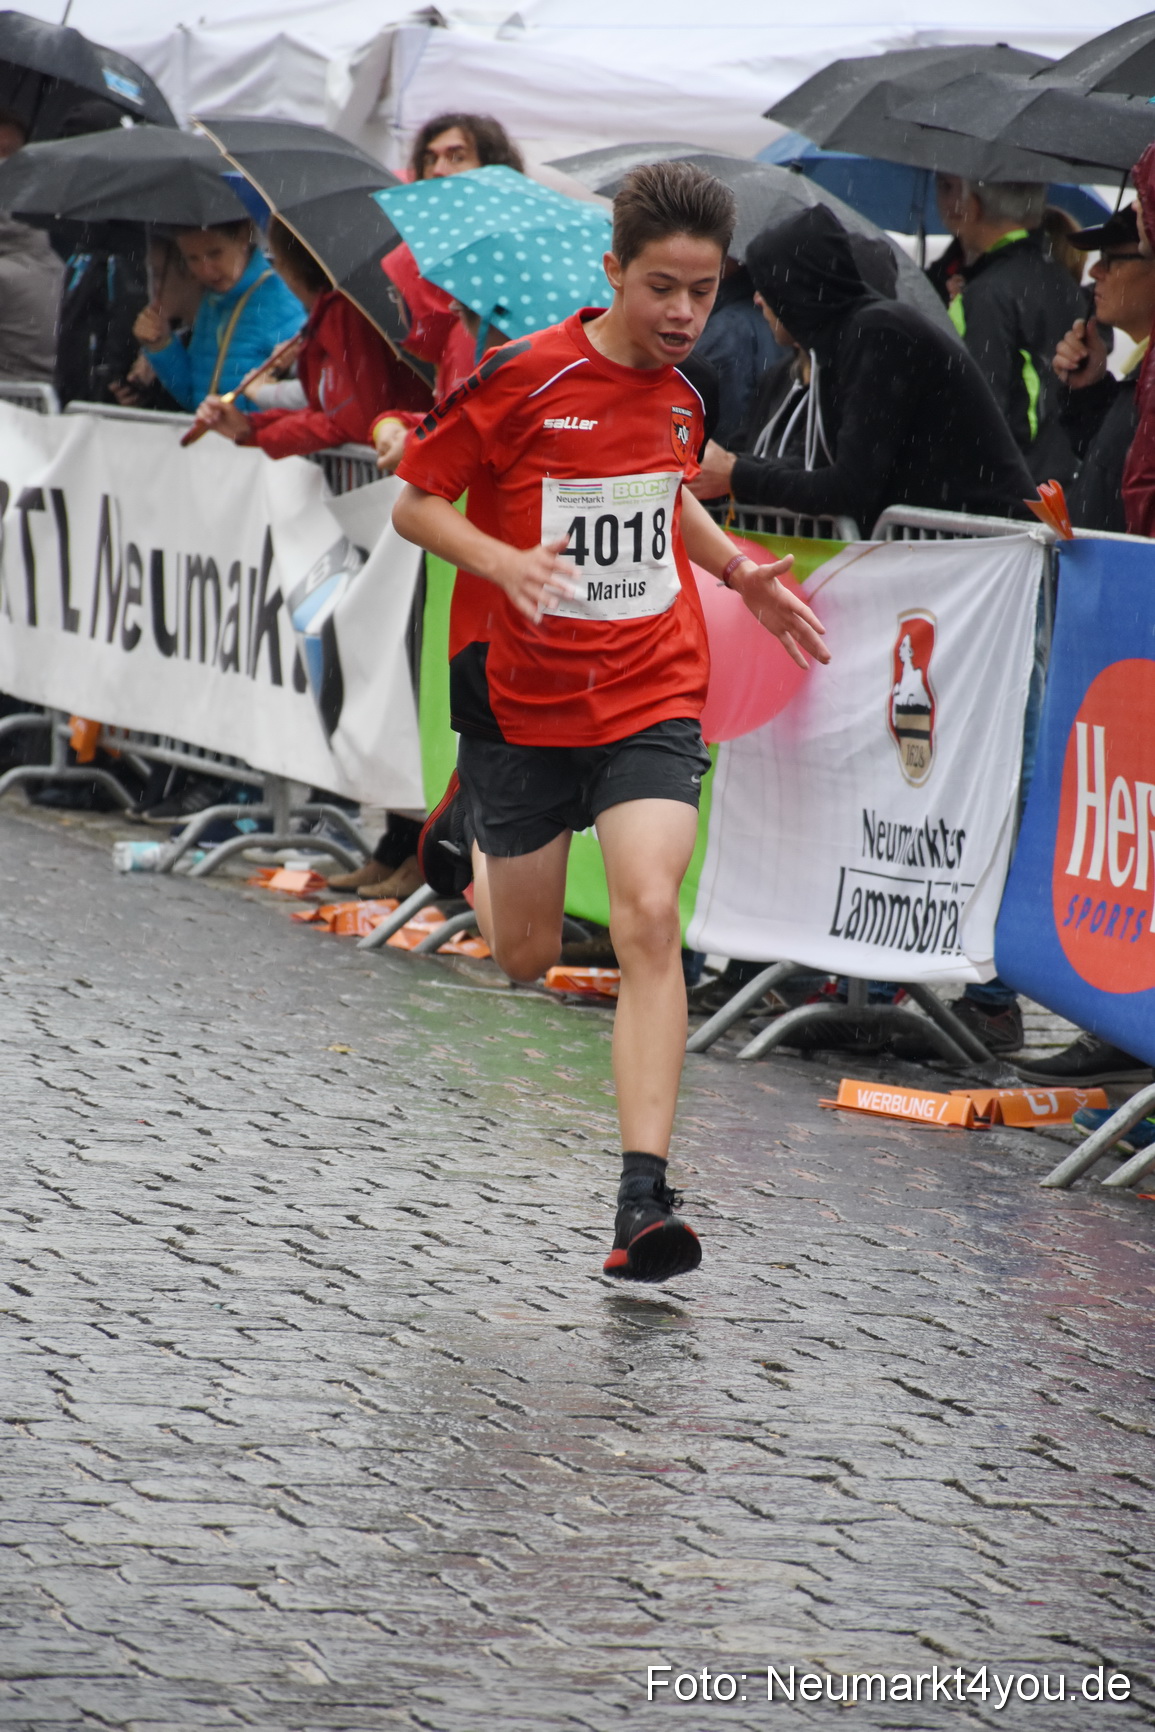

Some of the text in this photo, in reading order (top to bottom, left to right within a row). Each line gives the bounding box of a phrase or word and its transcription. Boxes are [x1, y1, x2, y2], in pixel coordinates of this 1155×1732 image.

[543, 416, 598, 431] saller
[613, 478, 671, 499] BOCK
[558, 507, 666, 566] 4018
[587, 579, 646, 601] Marius
[1065, 721, 1155, 932] Her
[829, 866, 965, 956] Lammsbrä
[1062, 894, 1147, 943] SPORTS
[857, 1088, 936, 1118] WERBUNG
